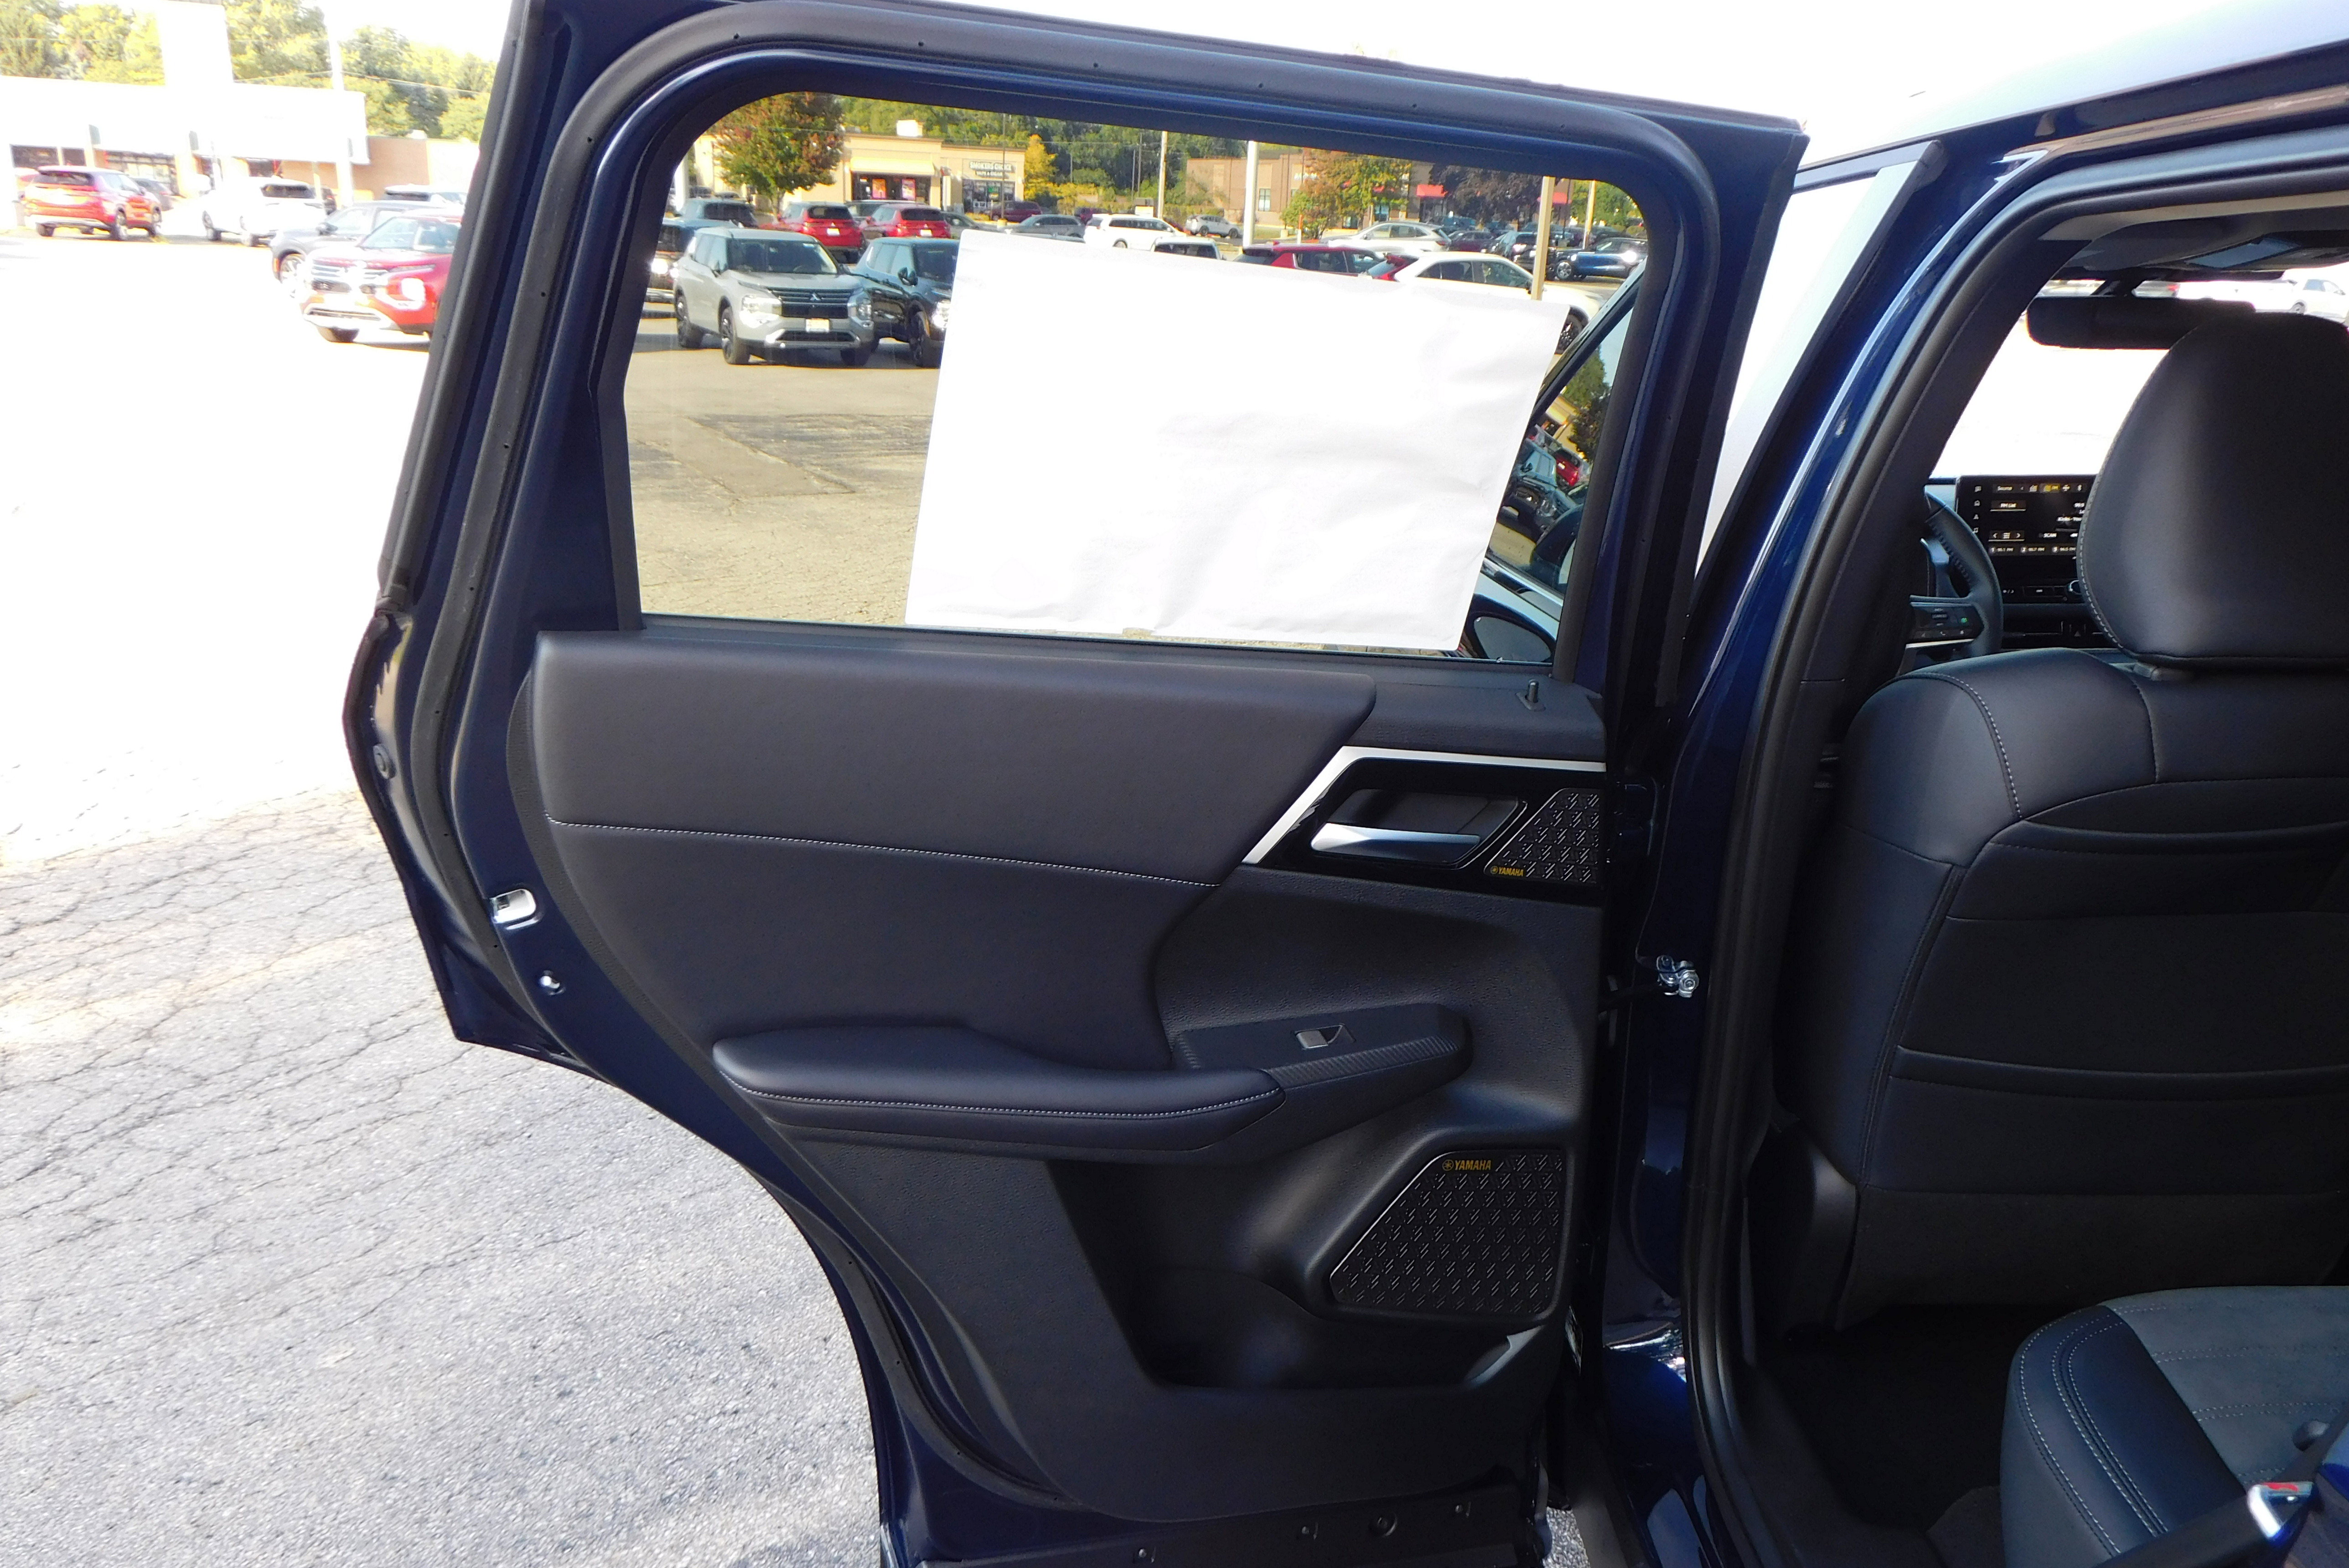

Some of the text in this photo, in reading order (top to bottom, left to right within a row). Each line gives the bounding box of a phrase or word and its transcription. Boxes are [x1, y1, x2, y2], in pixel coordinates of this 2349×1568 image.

[970, 161, 994, 170] SMOKERS
[1499, 867, 1524, 877] YAMAHA
[1455, 1160, 1491, 1171] YAMAHA
